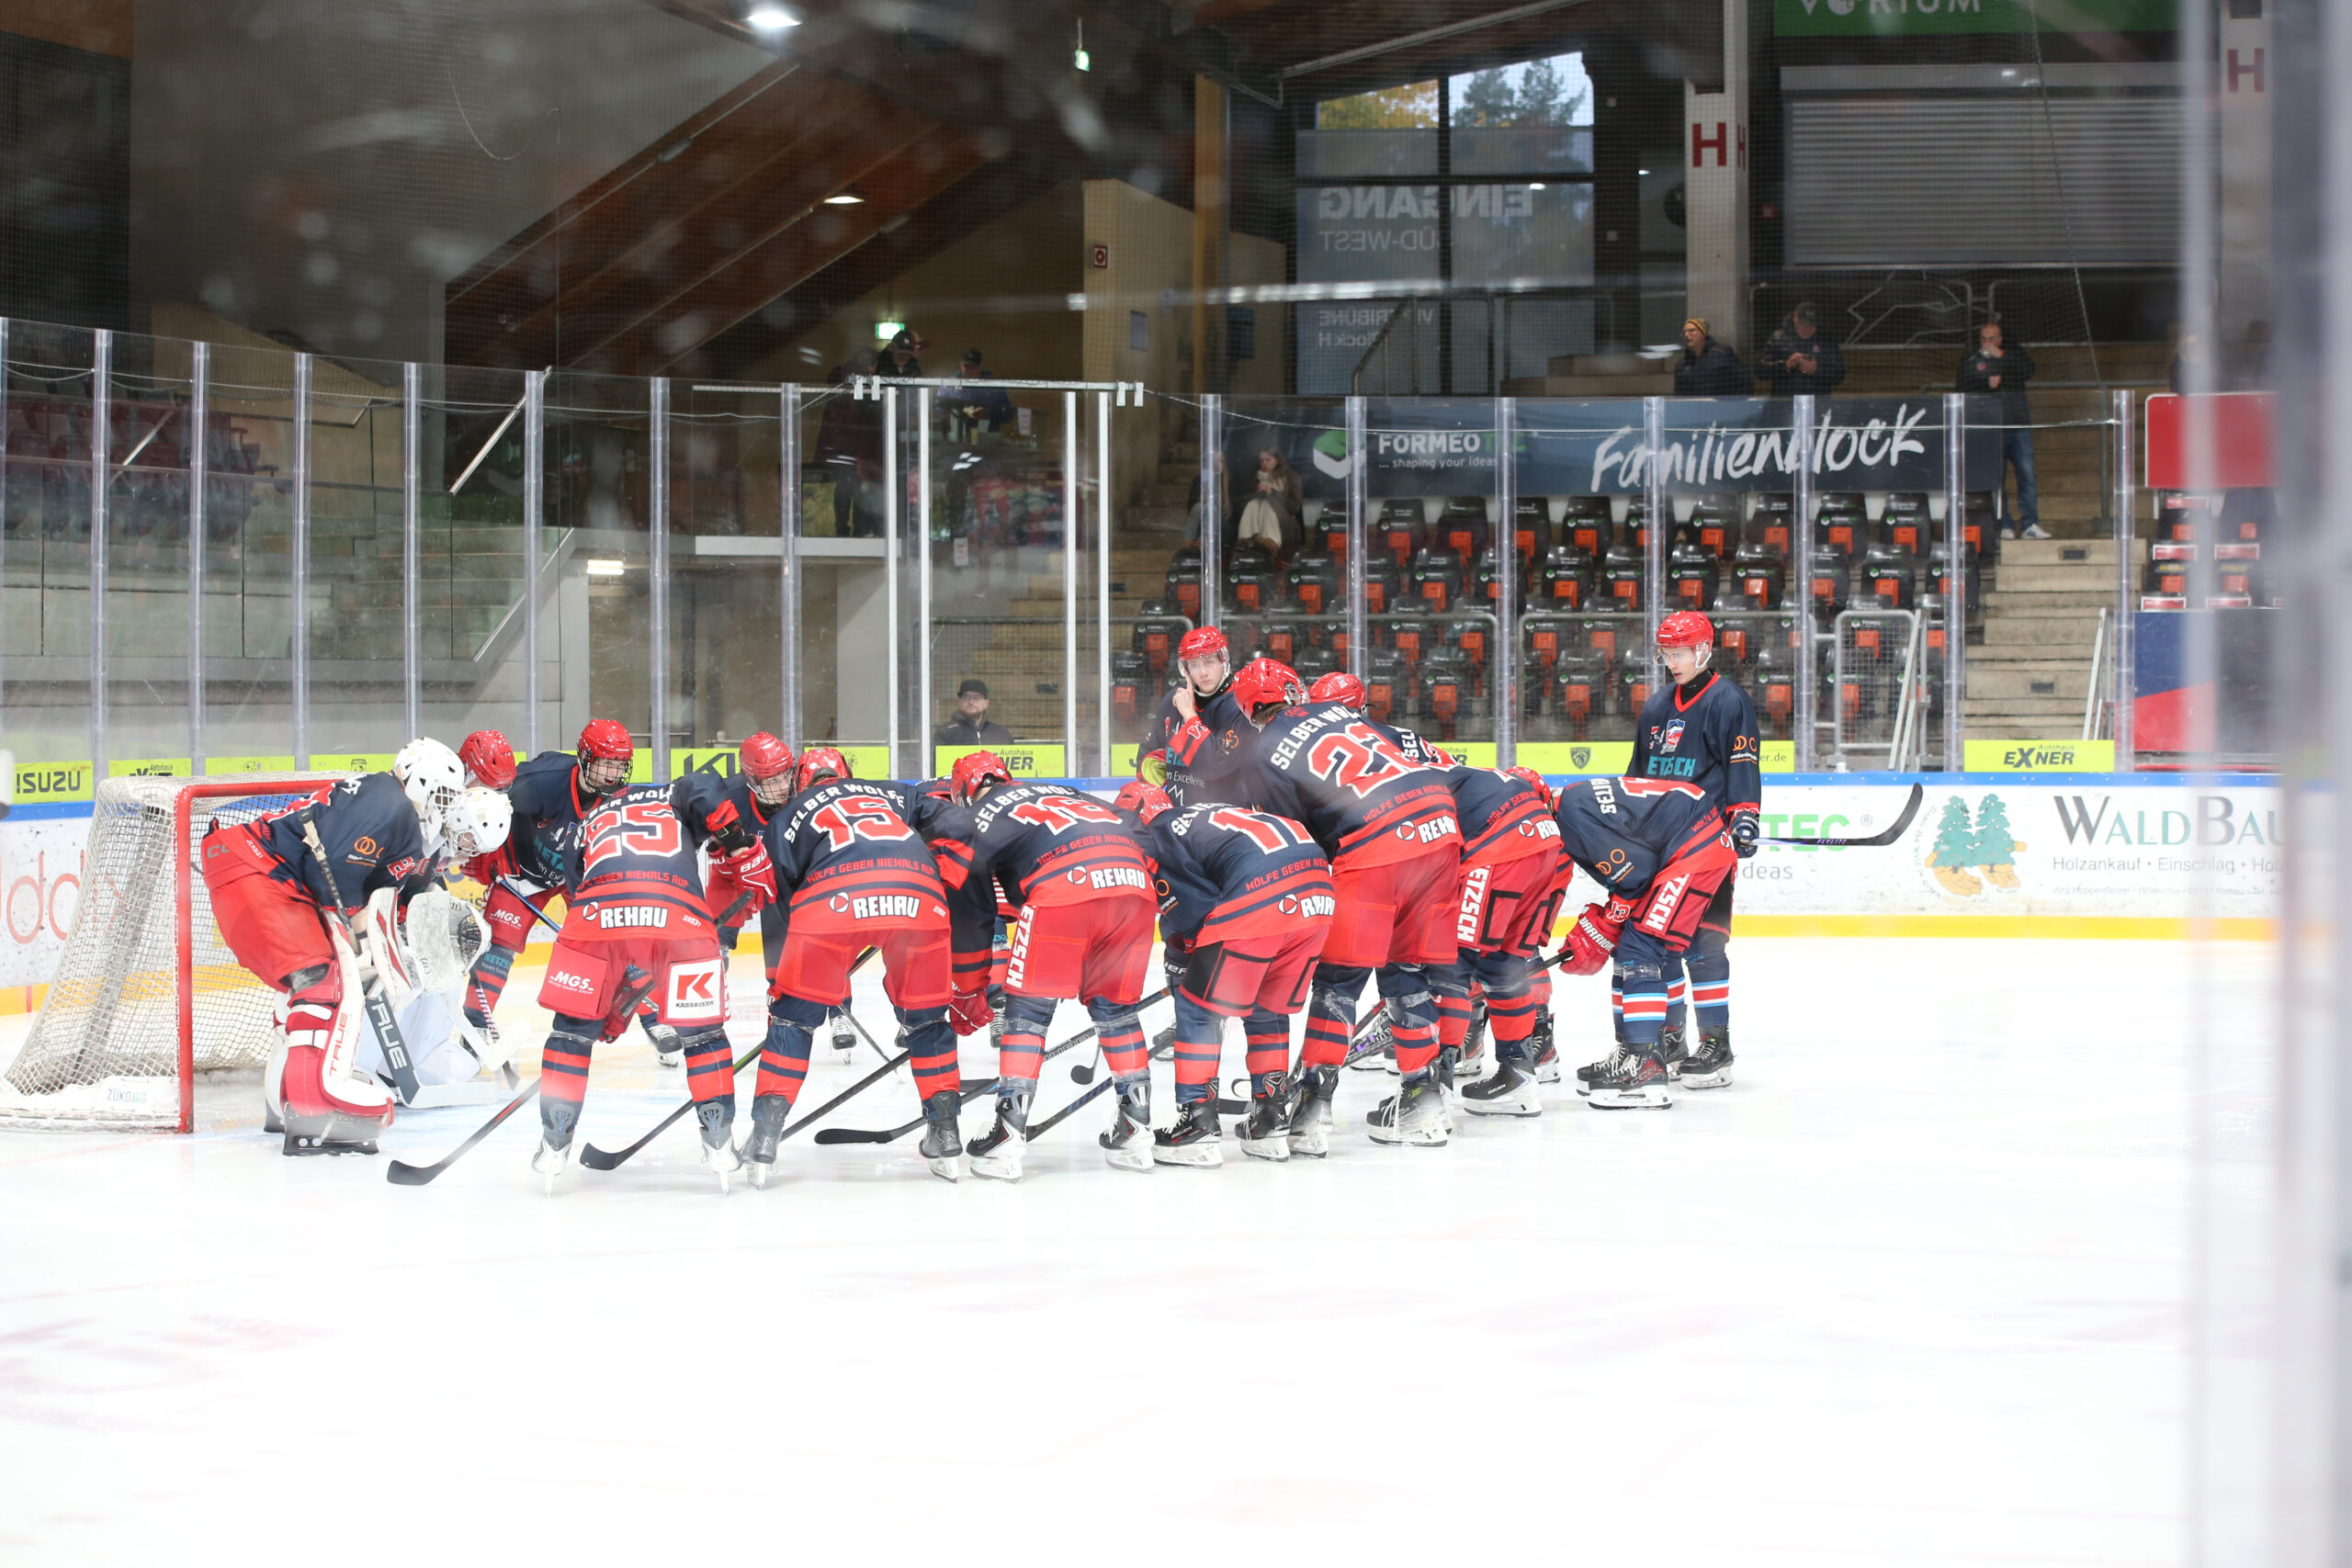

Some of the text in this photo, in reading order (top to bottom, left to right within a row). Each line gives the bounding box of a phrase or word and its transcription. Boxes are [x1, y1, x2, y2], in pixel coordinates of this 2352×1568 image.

[2227, 48, 2265, 93] H
[1691, 122, 1727, 168] H
[1392, 458, 1436, 469] shaping
[1439, 457, 1465, 468] your
[1468, 457, 1498, 468] ideas
[1271, 717, 1329, 771] SELBER
[2037, 743, 2075, 751] Autohaus
[2004, 747, 2075, 769] EXNER
[17, 770, 81, 794] ISUZU
[784, 786, 842, 844] SELBER
[975, 787, 1036, 833] SELBER
[809, 795, 914, 853] 15
[582, 801, 683, 882] 25
[626, 870, 670, 882] NIEMALS
[839, 860, 874, 874] GEBEN
[876, 858, 920, 871] NIEMALS
[1282, 860, 1311, 876] GEBEN
[2053, 857, 2142, 872] Holzankauf
[1090, 868, 1147, 890] REHAU
[853, 895, 921, 919] REHAU
[1457, 865, 1491, 943] ETZSCH
[1645, 873, 1690, 931] TZSCH
[493, 908, 521, 925] MGS
[600, 906, 668, 931] REHAU
[1006, 905, 1036, 989] ETZSCH
[554, 971, 591, 990] MGS
[675, 999, 715, 1009] KASSECKER
[329, 1011, 348, 1077] TRUE
